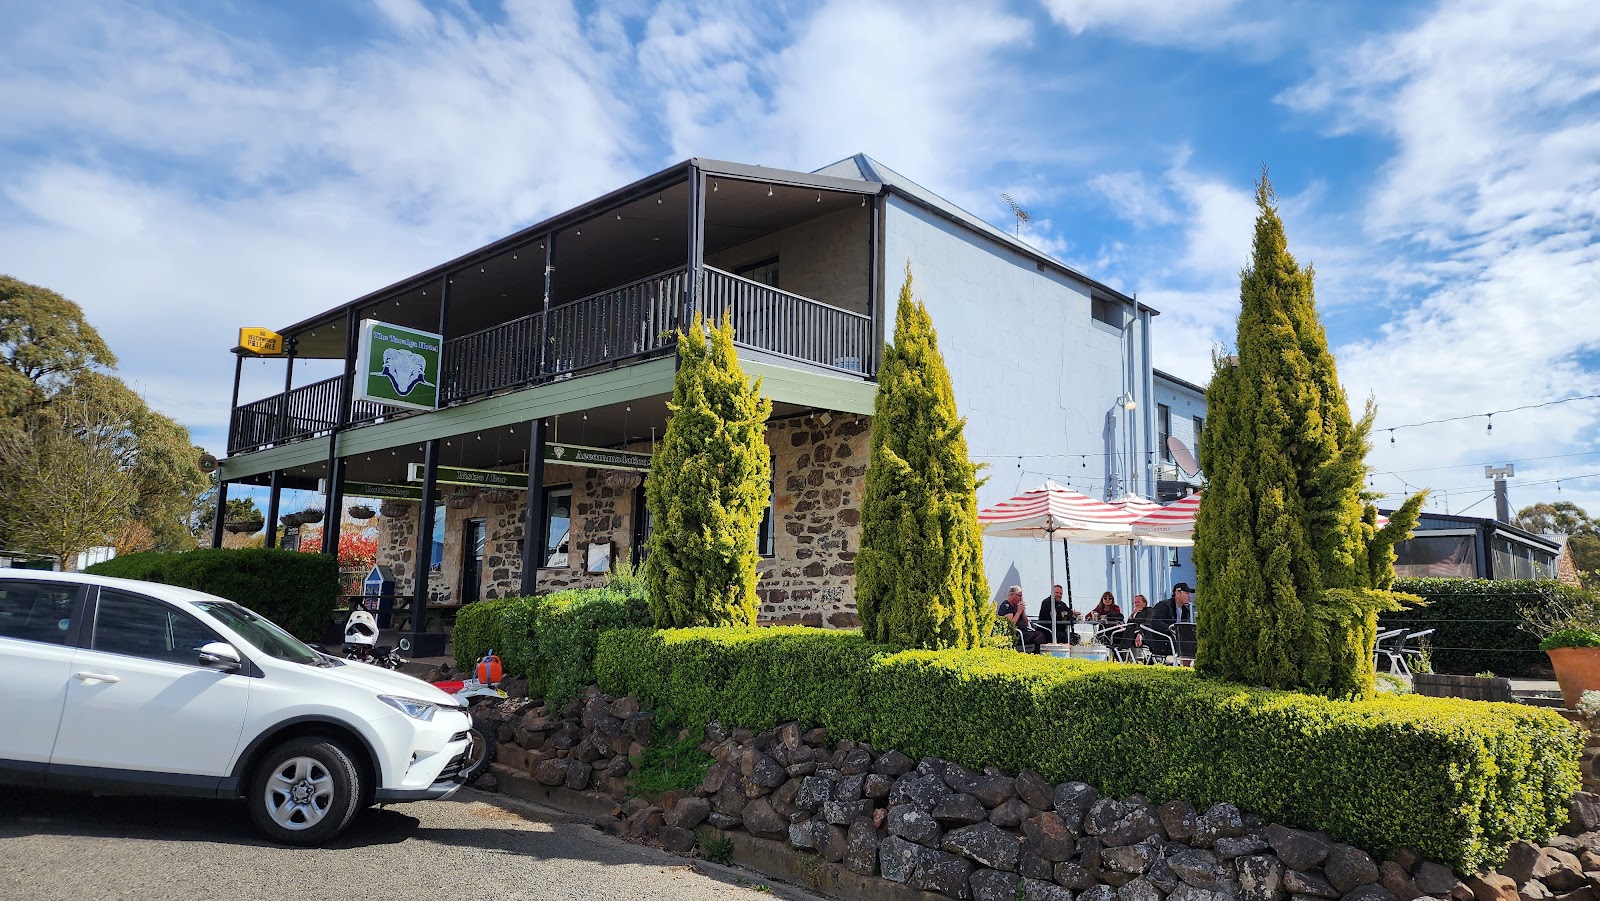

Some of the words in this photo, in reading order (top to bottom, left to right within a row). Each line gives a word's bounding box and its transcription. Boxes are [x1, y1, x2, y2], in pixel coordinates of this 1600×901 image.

[247, 339, 264, 349] PALE
[264, 342, 276, 351] ALE
[373, 331, 389, 341] The
[389, 335, 418, 349] Taralga
[418, 341, 439, 353] Hotel
[456, 471, 485, 481] Bistro
[490, 473, 507, 484] Bar
[364, 485, 410, 498] Bottleshop
